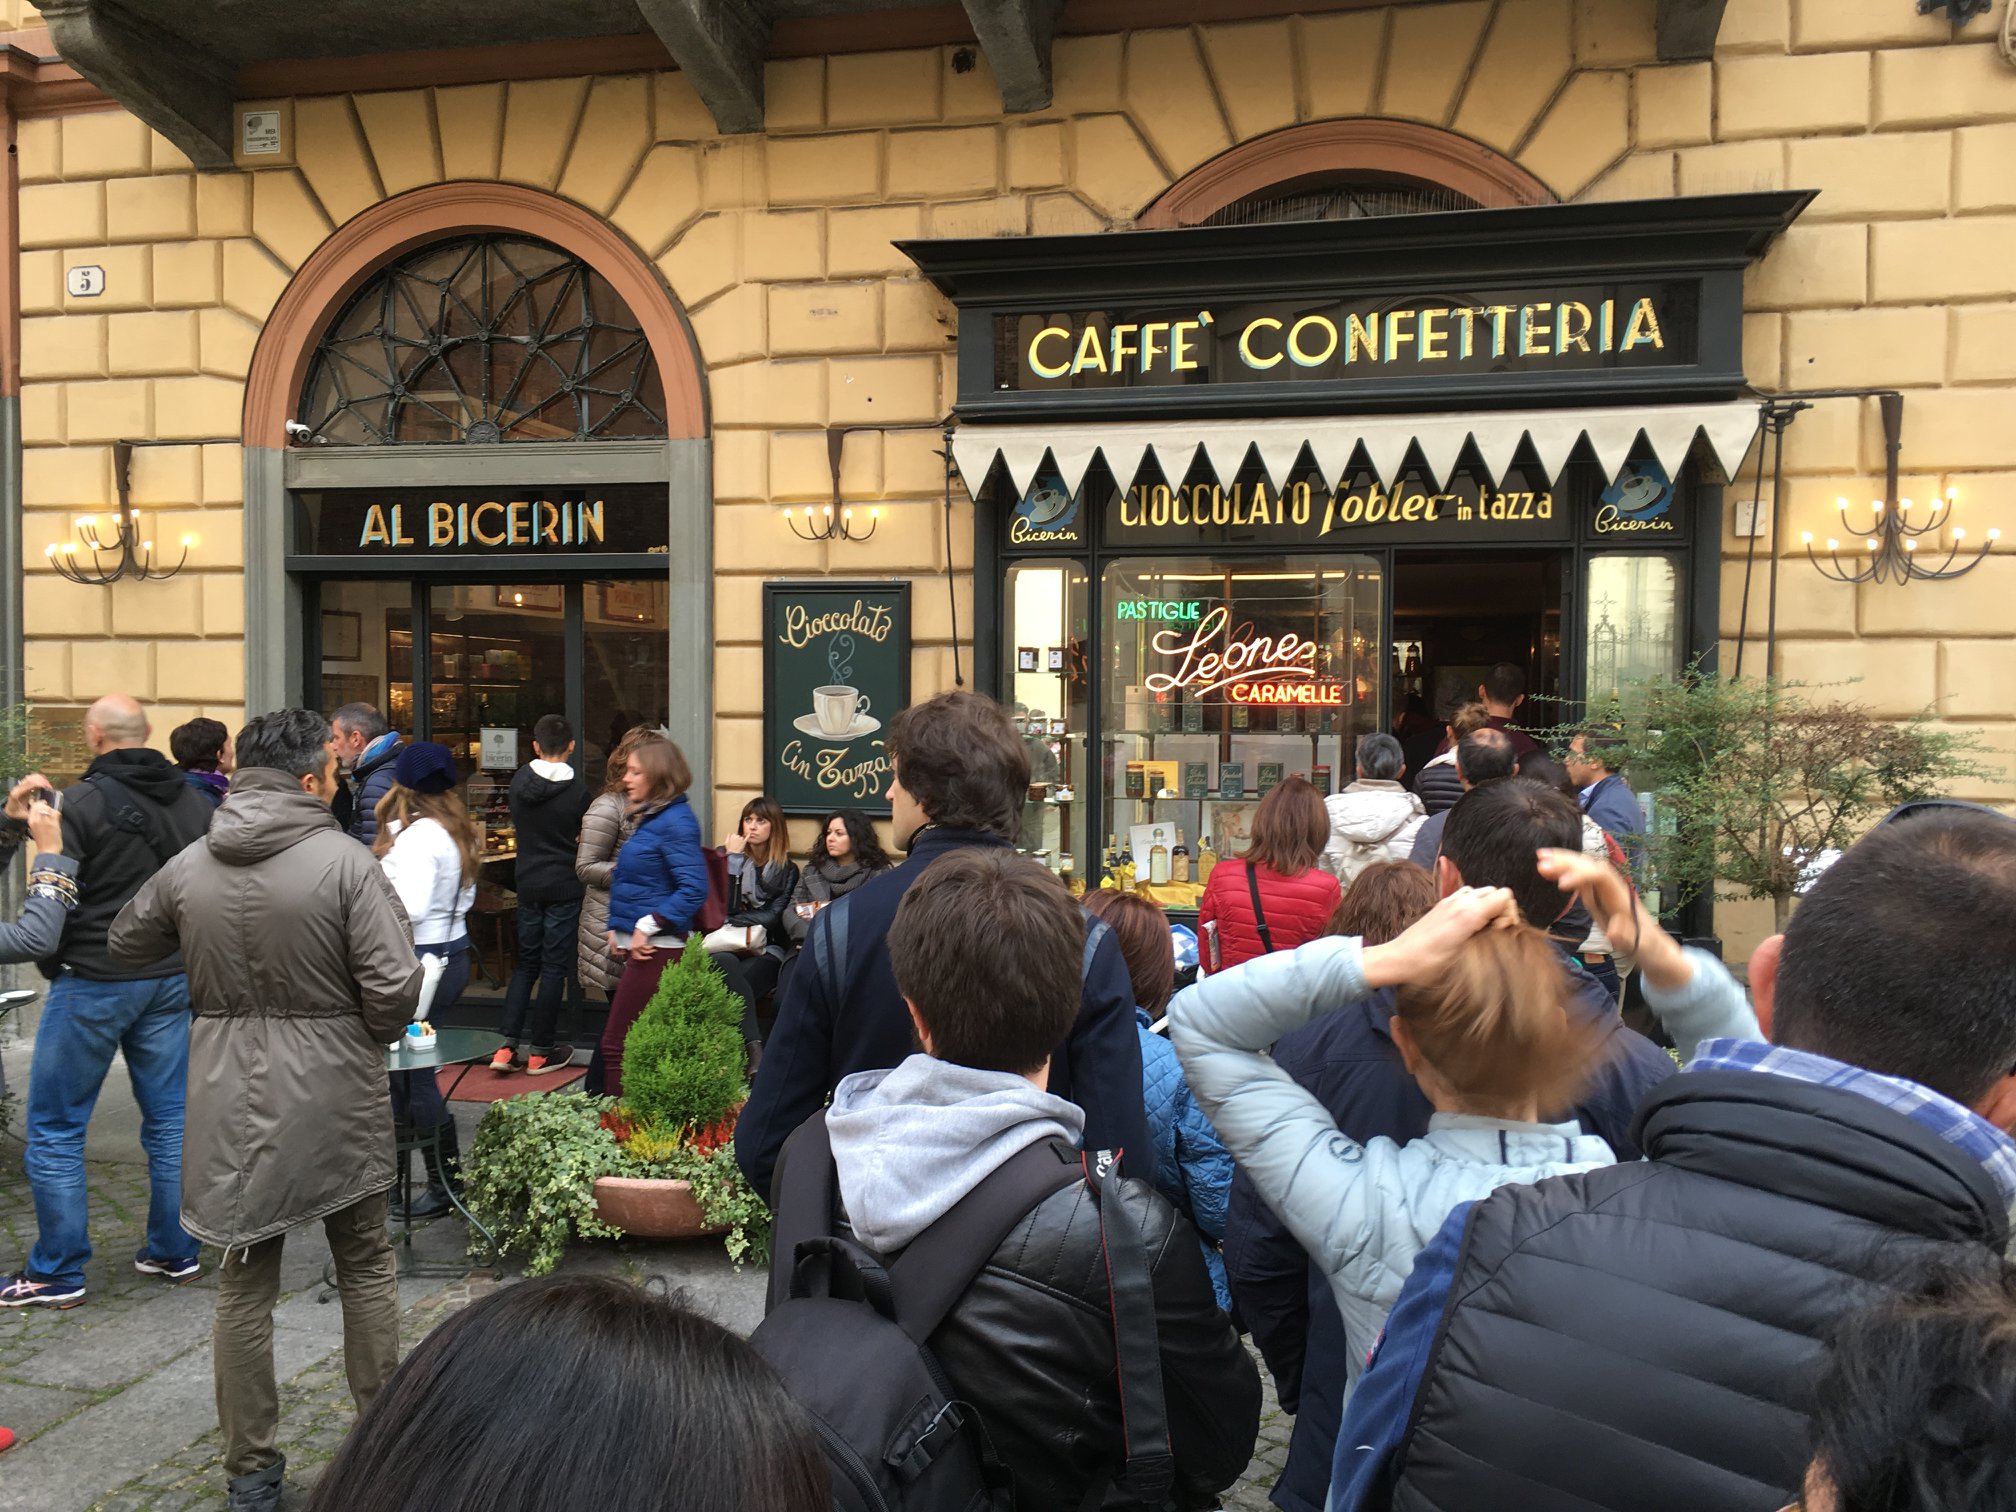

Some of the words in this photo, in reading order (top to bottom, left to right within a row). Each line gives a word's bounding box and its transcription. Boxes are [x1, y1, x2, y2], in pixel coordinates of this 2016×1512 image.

[80, 270, 91, 291] 5
[1238, 297, 1665, 370] CONFETTERIA
[359, 503, 415, 547] AL
[428, 500, 605, 547] BICERIN
[1120, 482, 1311, 526] CIOCCOLATO
[1457, 496, 1472, 521] in
[1479, 484, 1552, 520] tazza
[1595, 504, 1675, 533] Bicerin
[1010, 516, 1079, 544] Bicerin
[779, 600, 892, 648] Cioccolato
[1231, 683, 1342, 704] CARAMELLE
[815, 745, 892, 799] Tazza
